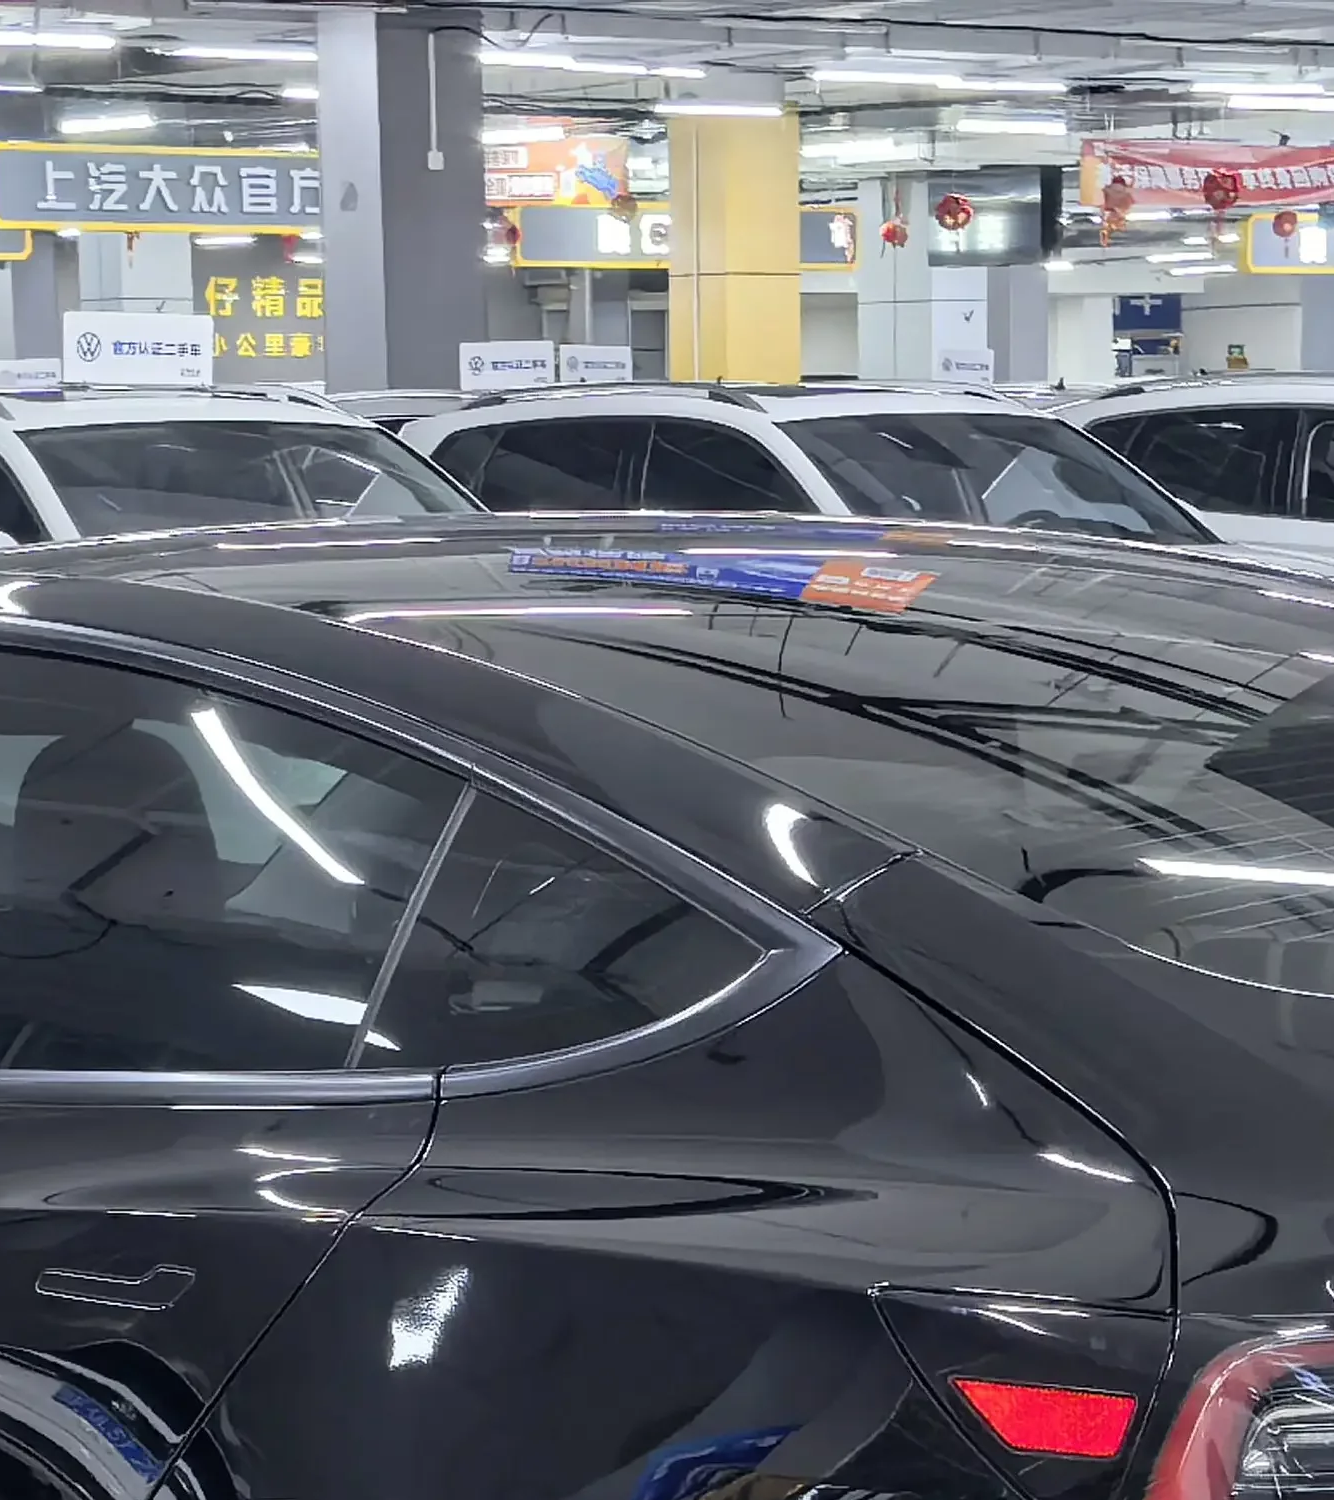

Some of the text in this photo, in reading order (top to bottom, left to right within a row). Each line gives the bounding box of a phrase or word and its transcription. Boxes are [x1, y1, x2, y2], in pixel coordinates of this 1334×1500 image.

[36, 160, 321, 214] 上汽大众官方
